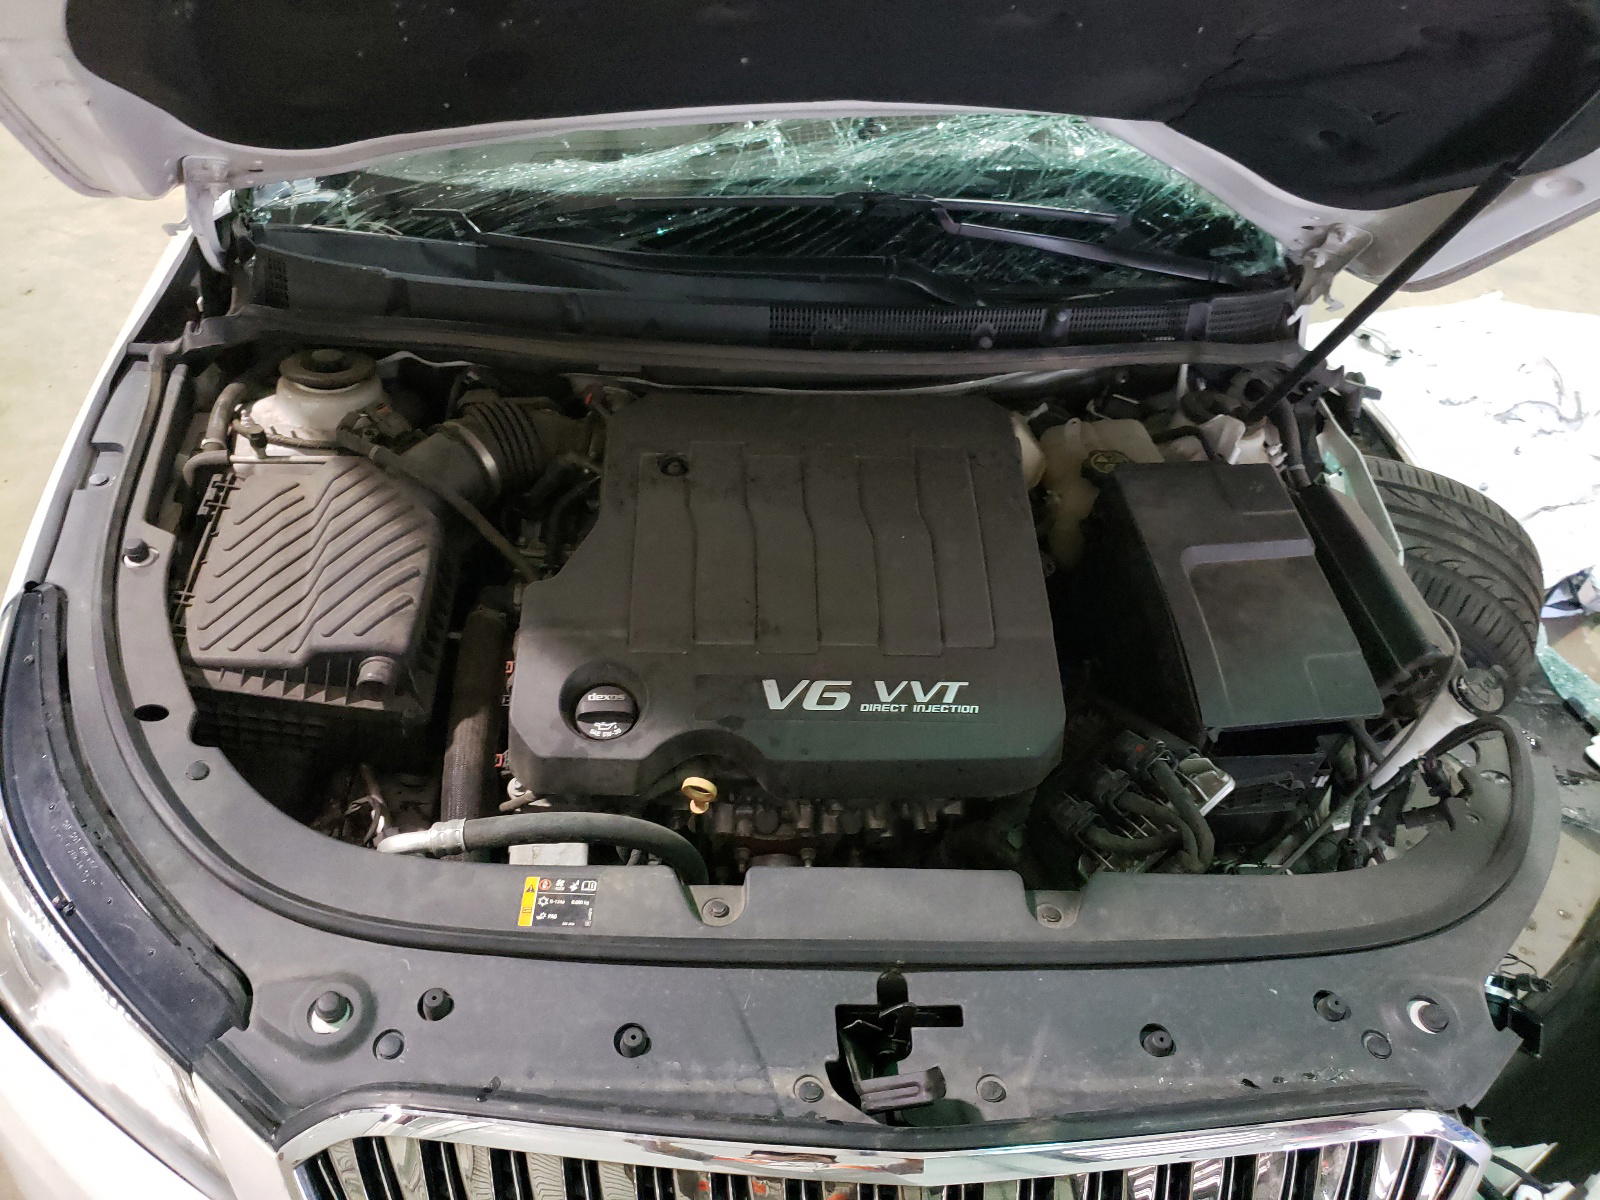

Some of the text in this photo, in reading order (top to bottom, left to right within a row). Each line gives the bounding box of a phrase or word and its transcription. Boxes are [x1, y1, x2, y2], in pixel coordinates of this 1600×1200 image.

[588, 693, 625, 701] dexos
[761, 679, 970, 711] V6 VVT
[860, 703, 980, 714] DIRECT INJECTION
